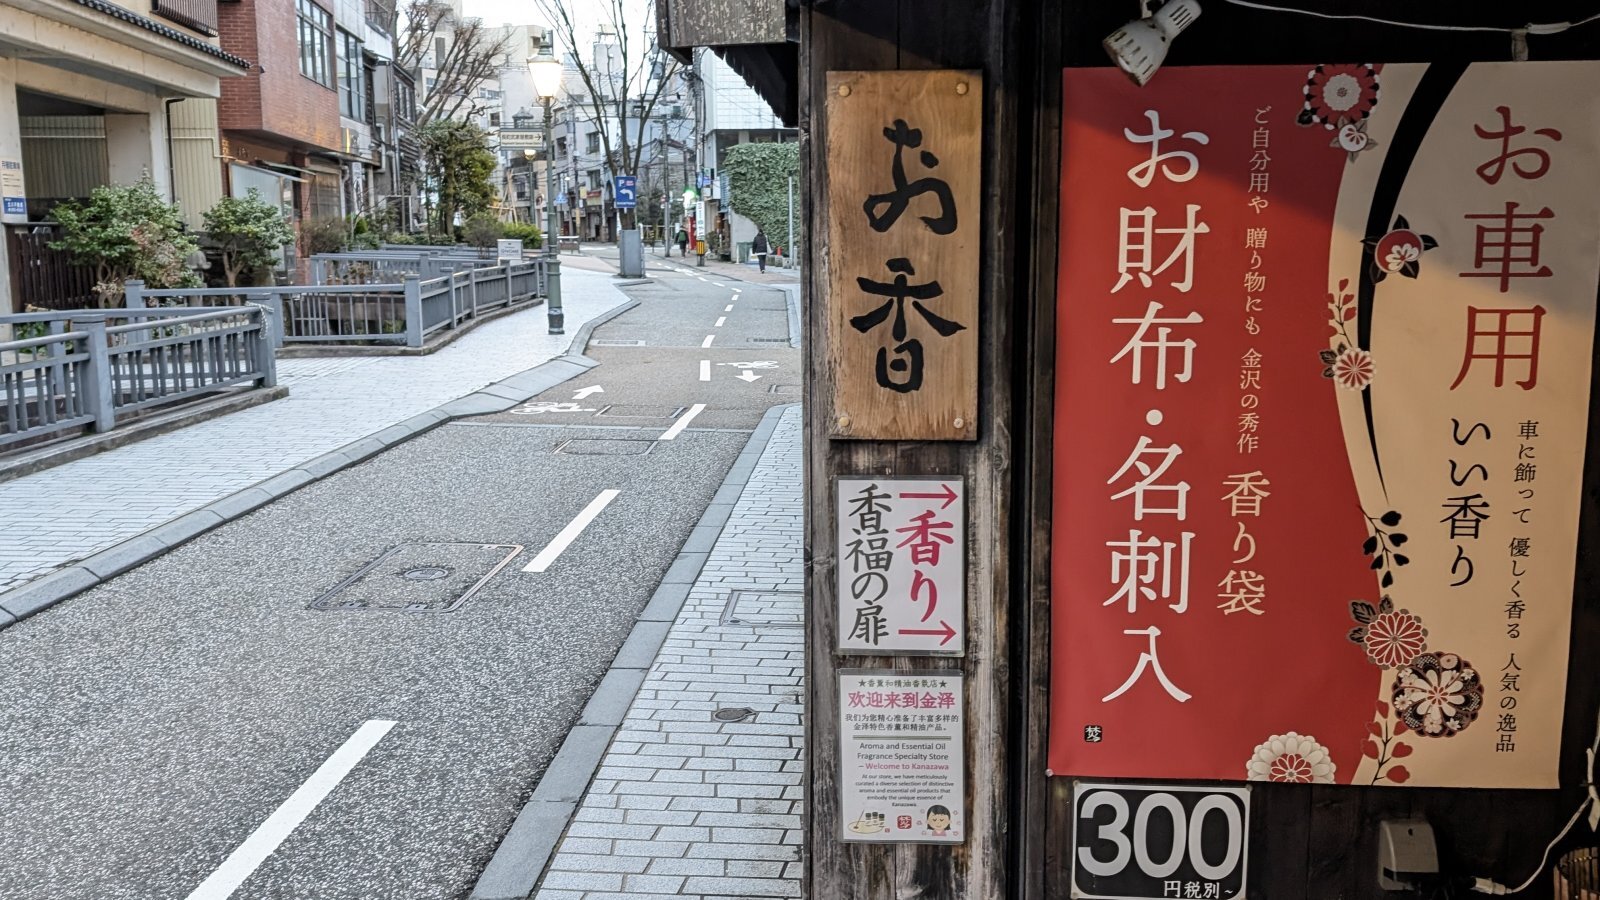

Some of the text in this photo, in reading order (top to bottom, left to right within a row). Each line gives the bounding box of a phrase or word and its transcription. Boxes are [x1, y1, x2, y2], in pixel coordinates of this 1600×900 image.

[850, 118, 967, 393] お香
[1236, 105, 1272, 454] ご自分用や 贈り物にも 金沢の秀作
[1450, 105, 1562, 391] お車用
[1102, 110, 1210, 703] お財布・名刺入
[844, 483, 893, 646] 香福の扉
[895, 509, 954, 623] 香り
[1216, 469, 1271, 616] 香り袋
[1439, 417, 1491, 587] いい香り
[1495, 419, 1540, 753] 車に飾って 優しく香る 人気の逸品
[848, 691, 956, 709] 欢迎来到金泽
[857, 753, 893, 761] Fragrance
[894, 753, 928, 761] Specialty
[1078, 790, 1242, 880] 300
